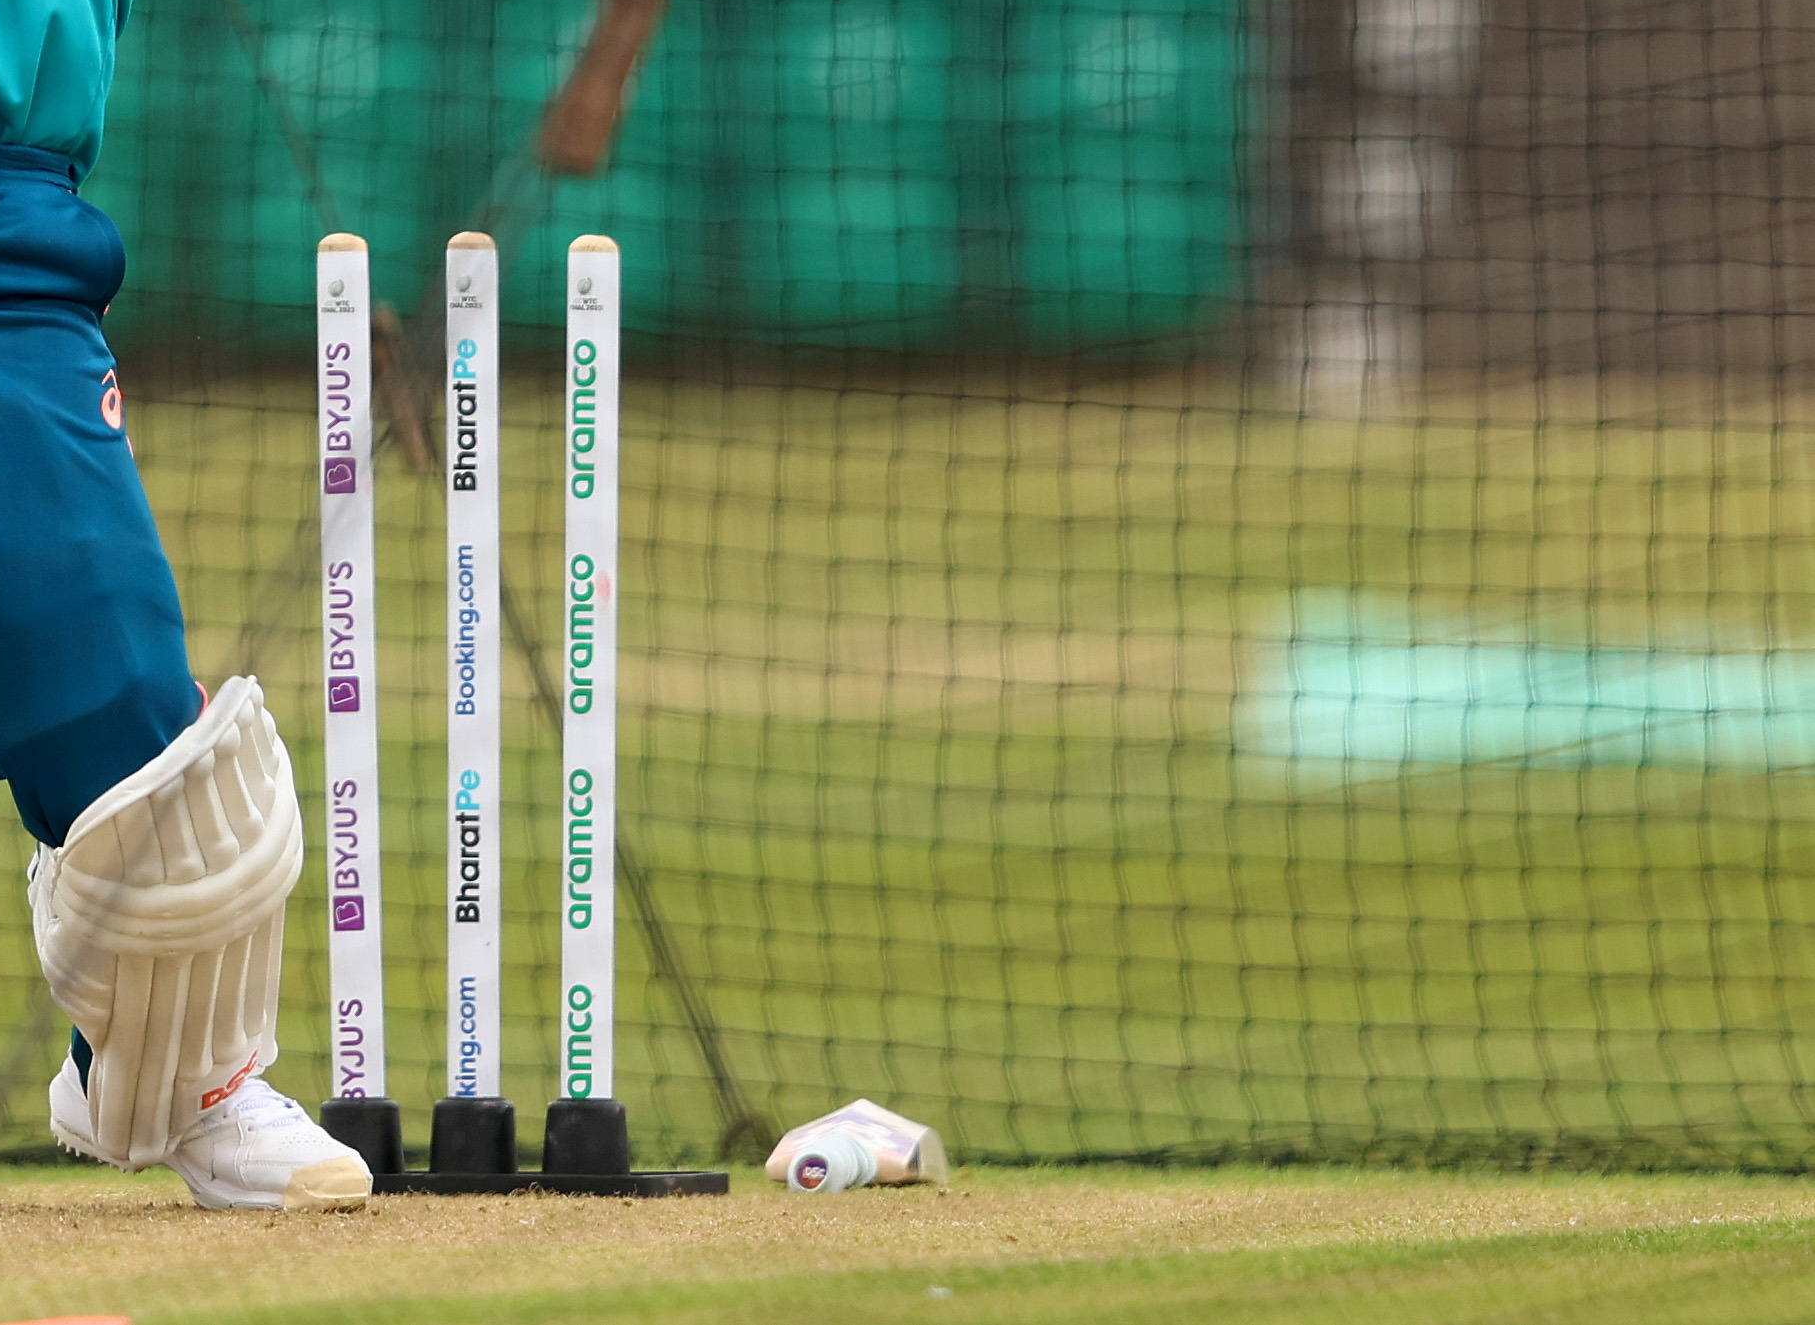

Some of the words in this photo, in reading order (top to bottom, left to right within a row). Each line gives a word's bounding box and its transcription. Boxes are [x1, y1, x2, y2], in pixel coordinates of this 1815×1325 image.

[326, 341, 352, 452] BYJU'S
[453, 338, 478, 492] BharatPe
[572, 338, 597, 499] aramco
[329, 561, 354, 670] BYJU'S
[453, 544, 480, 715] Booking.com
[570, 553, 594, 714] aramco
[334, 779, 360, 889] BYJU'S
[455, 769, 480, 924] BharatPe
[568, 768, 593, 929] aramco
